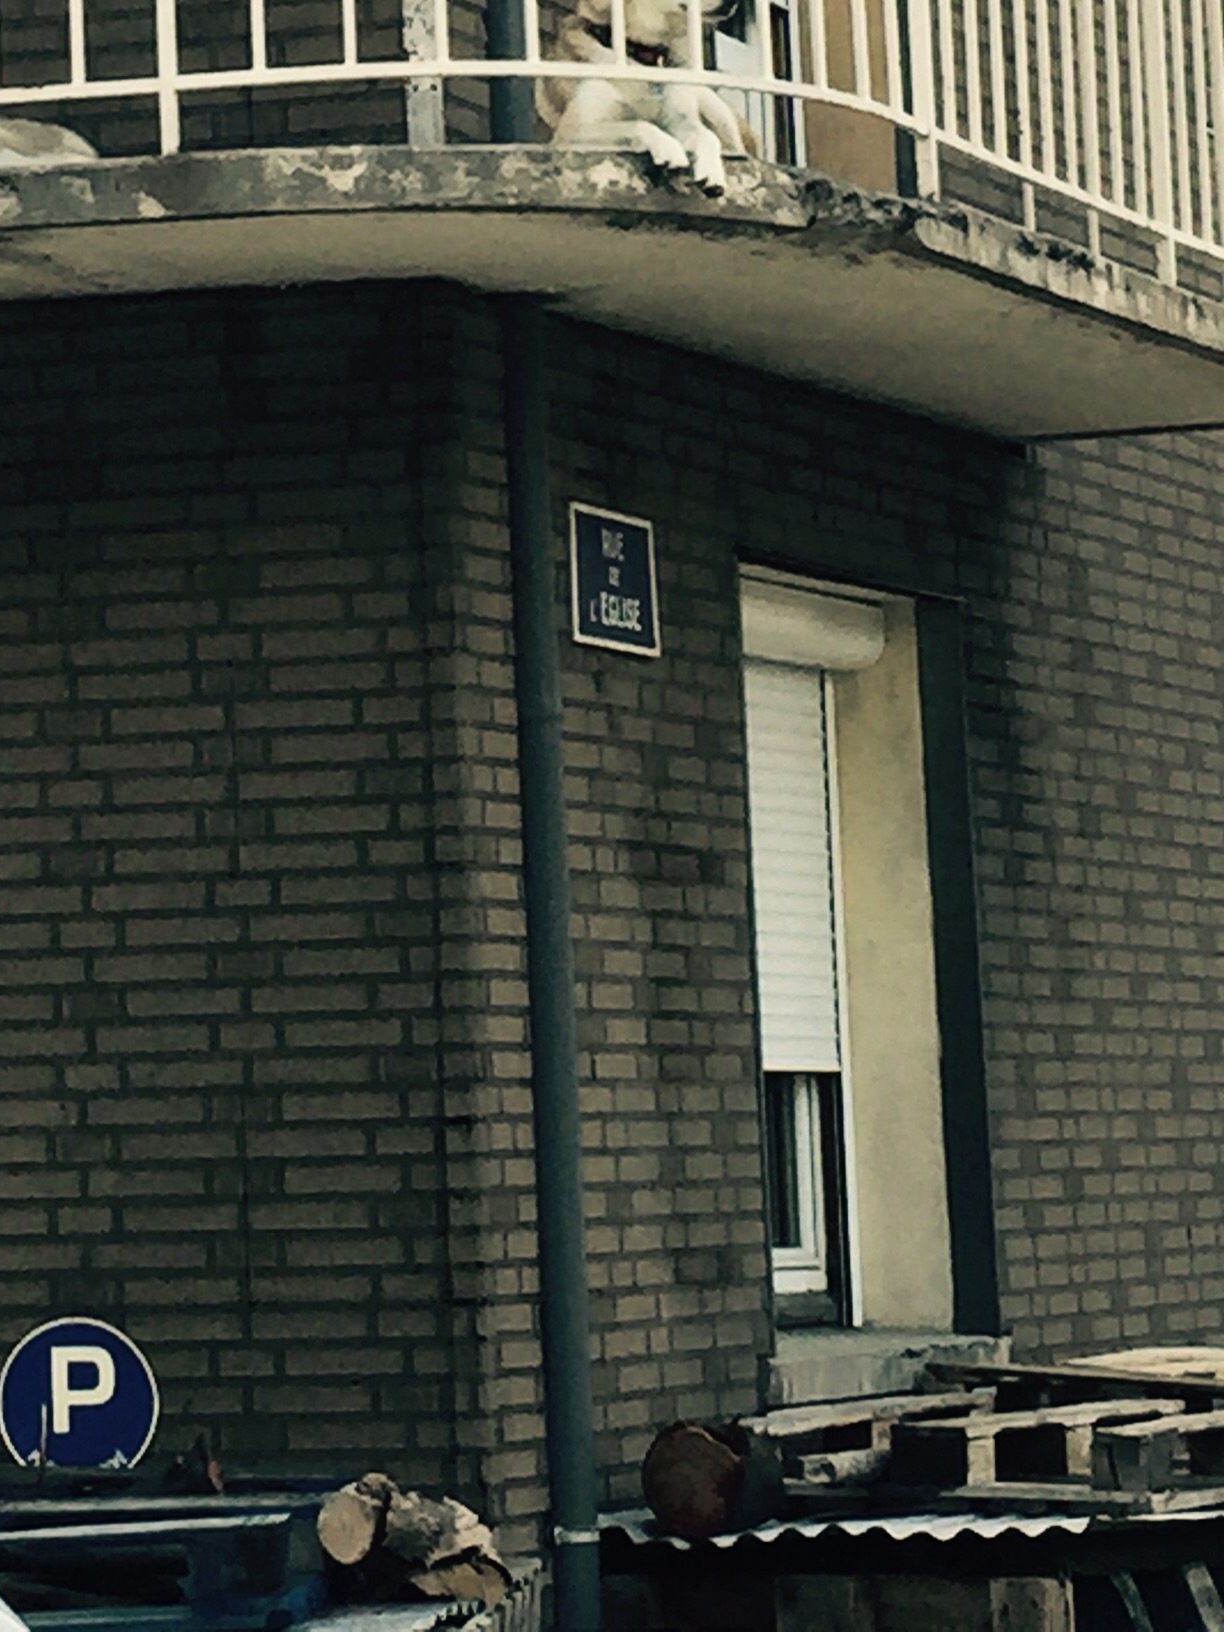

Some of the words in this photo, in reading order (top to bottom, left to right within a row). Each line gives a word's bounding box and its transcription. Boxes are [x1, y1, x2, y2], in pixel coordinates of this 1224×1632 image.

[601, 528, 625, 561] RUE
[608, 565, 621, 587] DE
[50, 1345, 116, 1434] P
